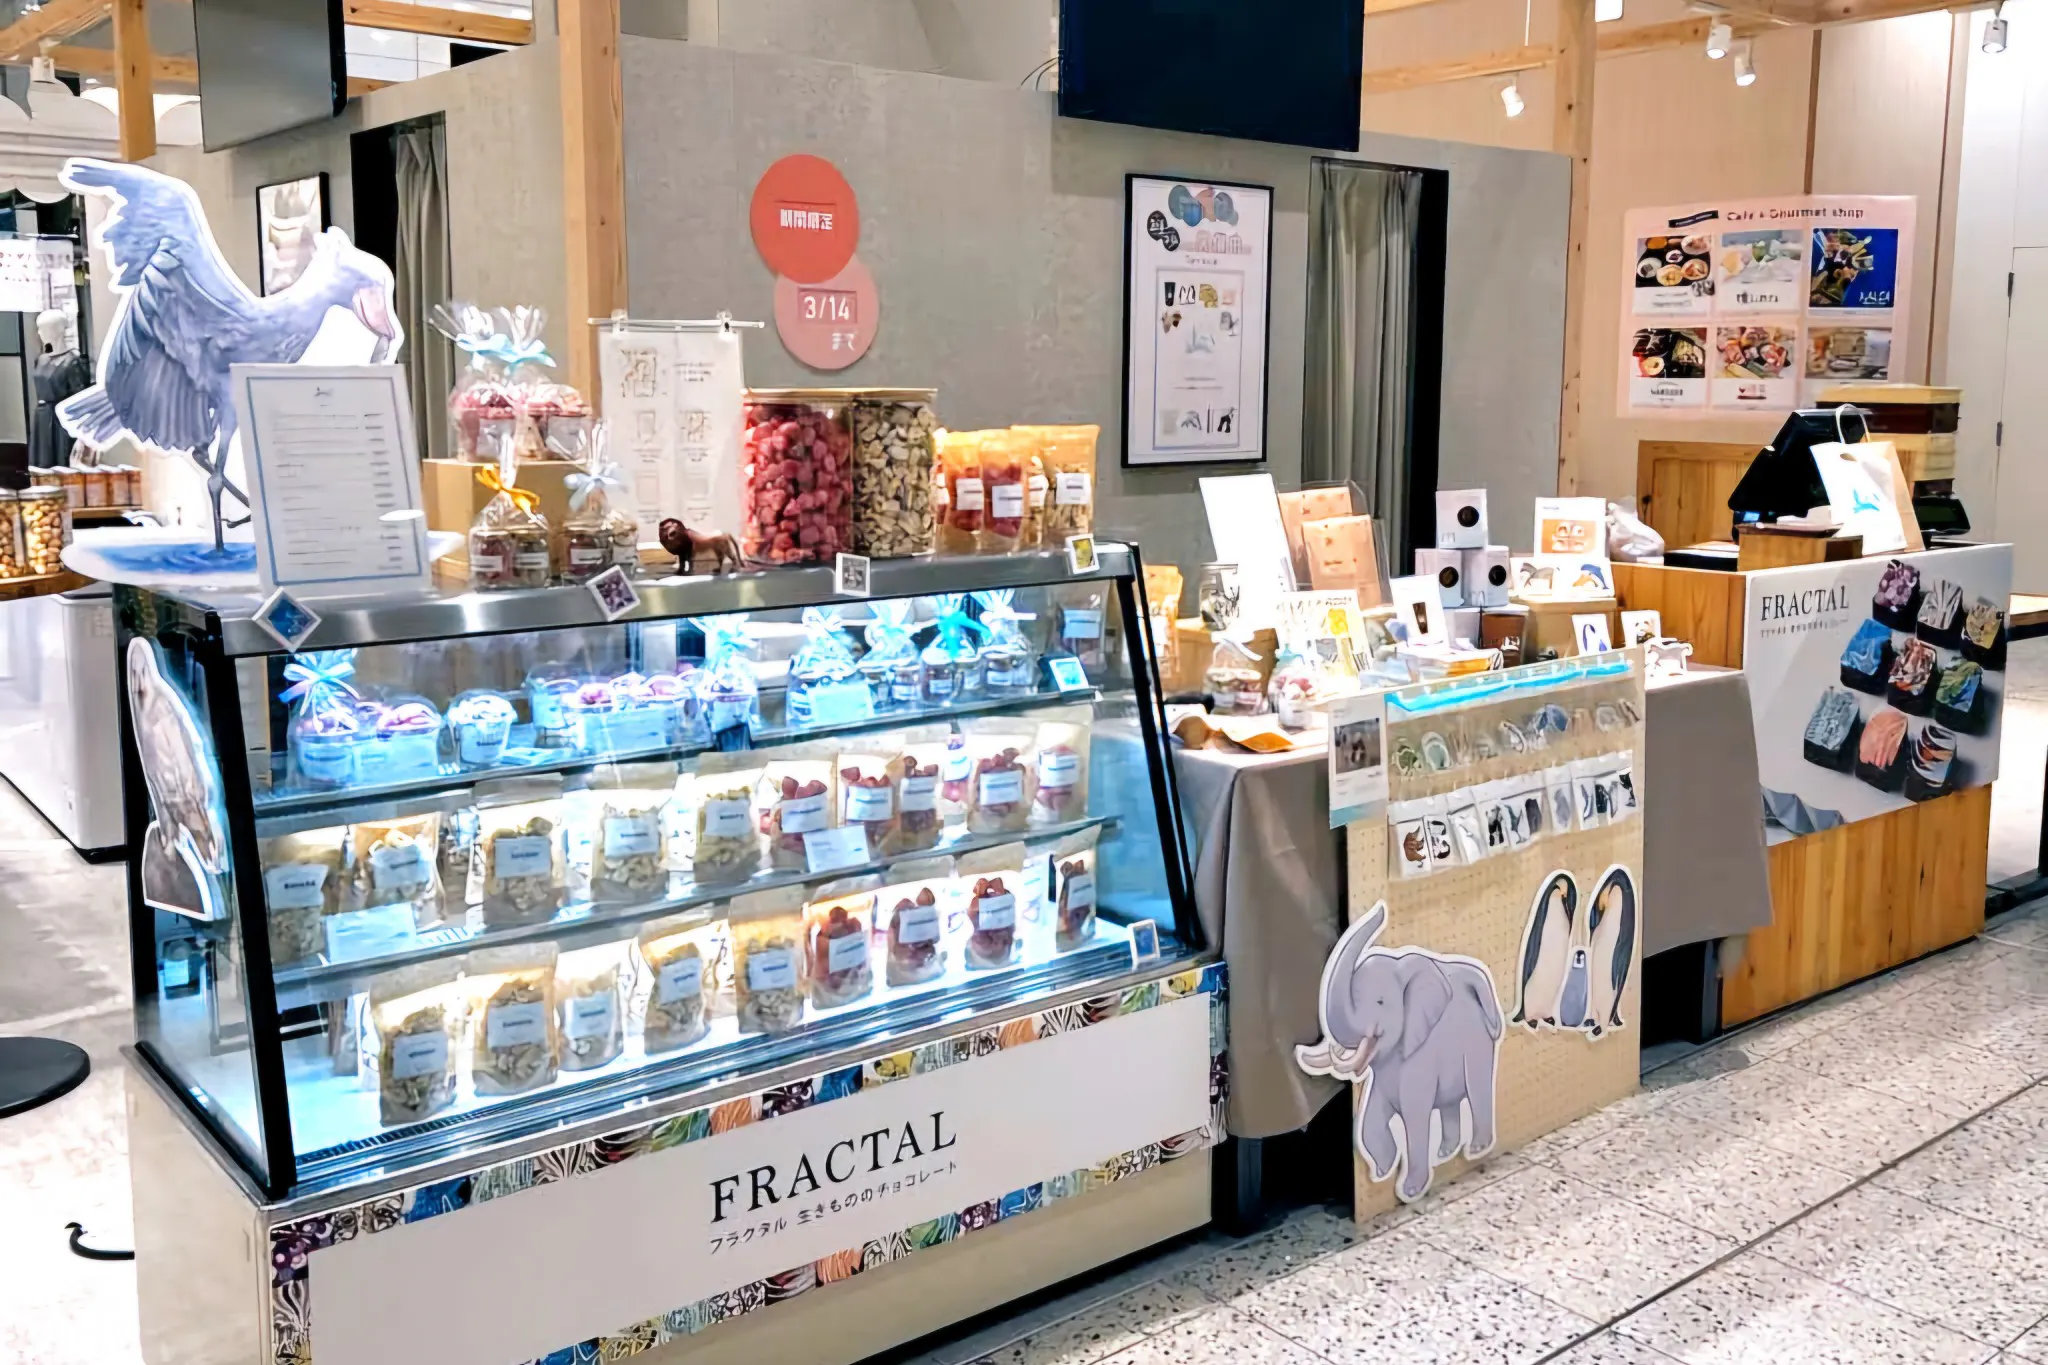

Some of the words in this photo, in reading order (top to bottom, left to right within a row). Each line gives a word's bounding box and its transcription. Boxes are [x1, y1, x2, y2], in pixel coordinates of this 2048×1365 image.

[803, 296, 850, 321] 3/14
[1760, 585, 1849, 621] FRACTAL
[709, 1111, 957, 1224] FRACTAL
[710, 1216, 788, 1255] フラクタル
[796, 1160, 957, 1226] 生きもののチョコレート
